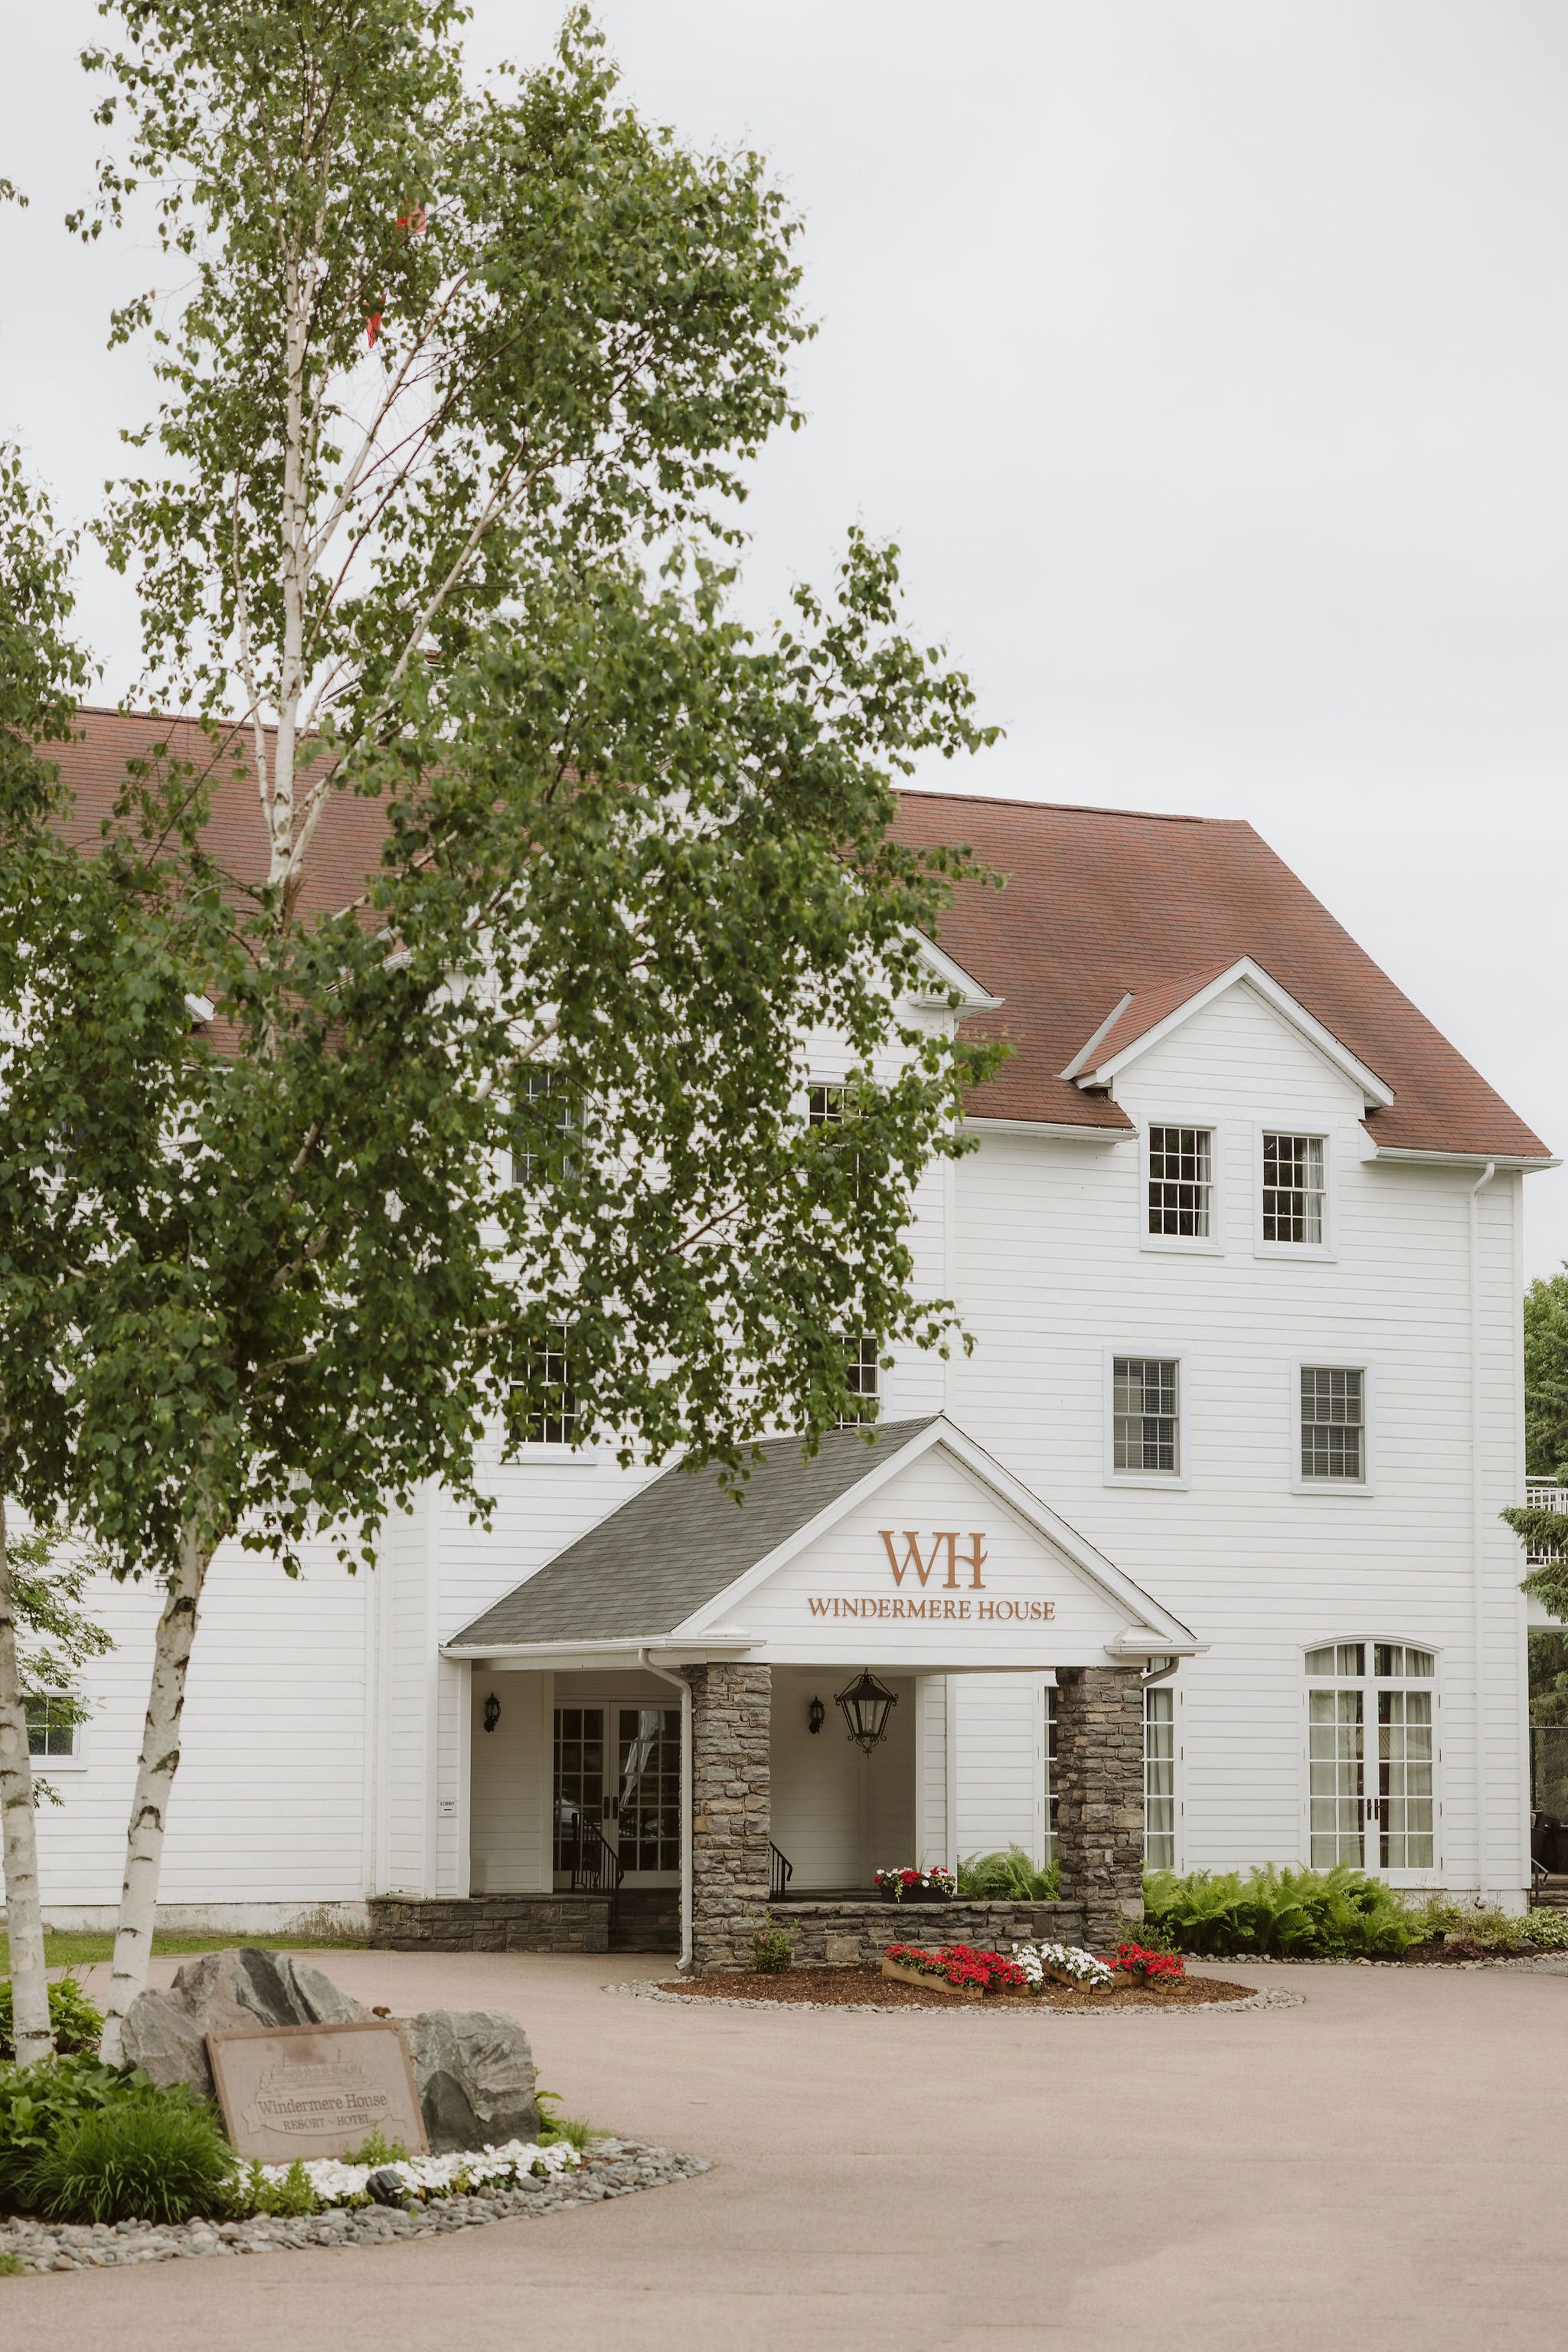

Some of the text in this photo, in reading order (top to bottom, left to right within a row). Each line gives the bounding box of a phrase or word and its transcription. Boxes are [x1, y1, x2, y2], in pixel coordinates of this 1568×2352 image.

[877, 1530, 988, 1589] WH
[807, 1597, 1056, 1620] WINDERMERE HOUSE
[257, 2093, 387, 2115] Windermere House
[283, 2114, 373, 2130] RESORT HOTEL
